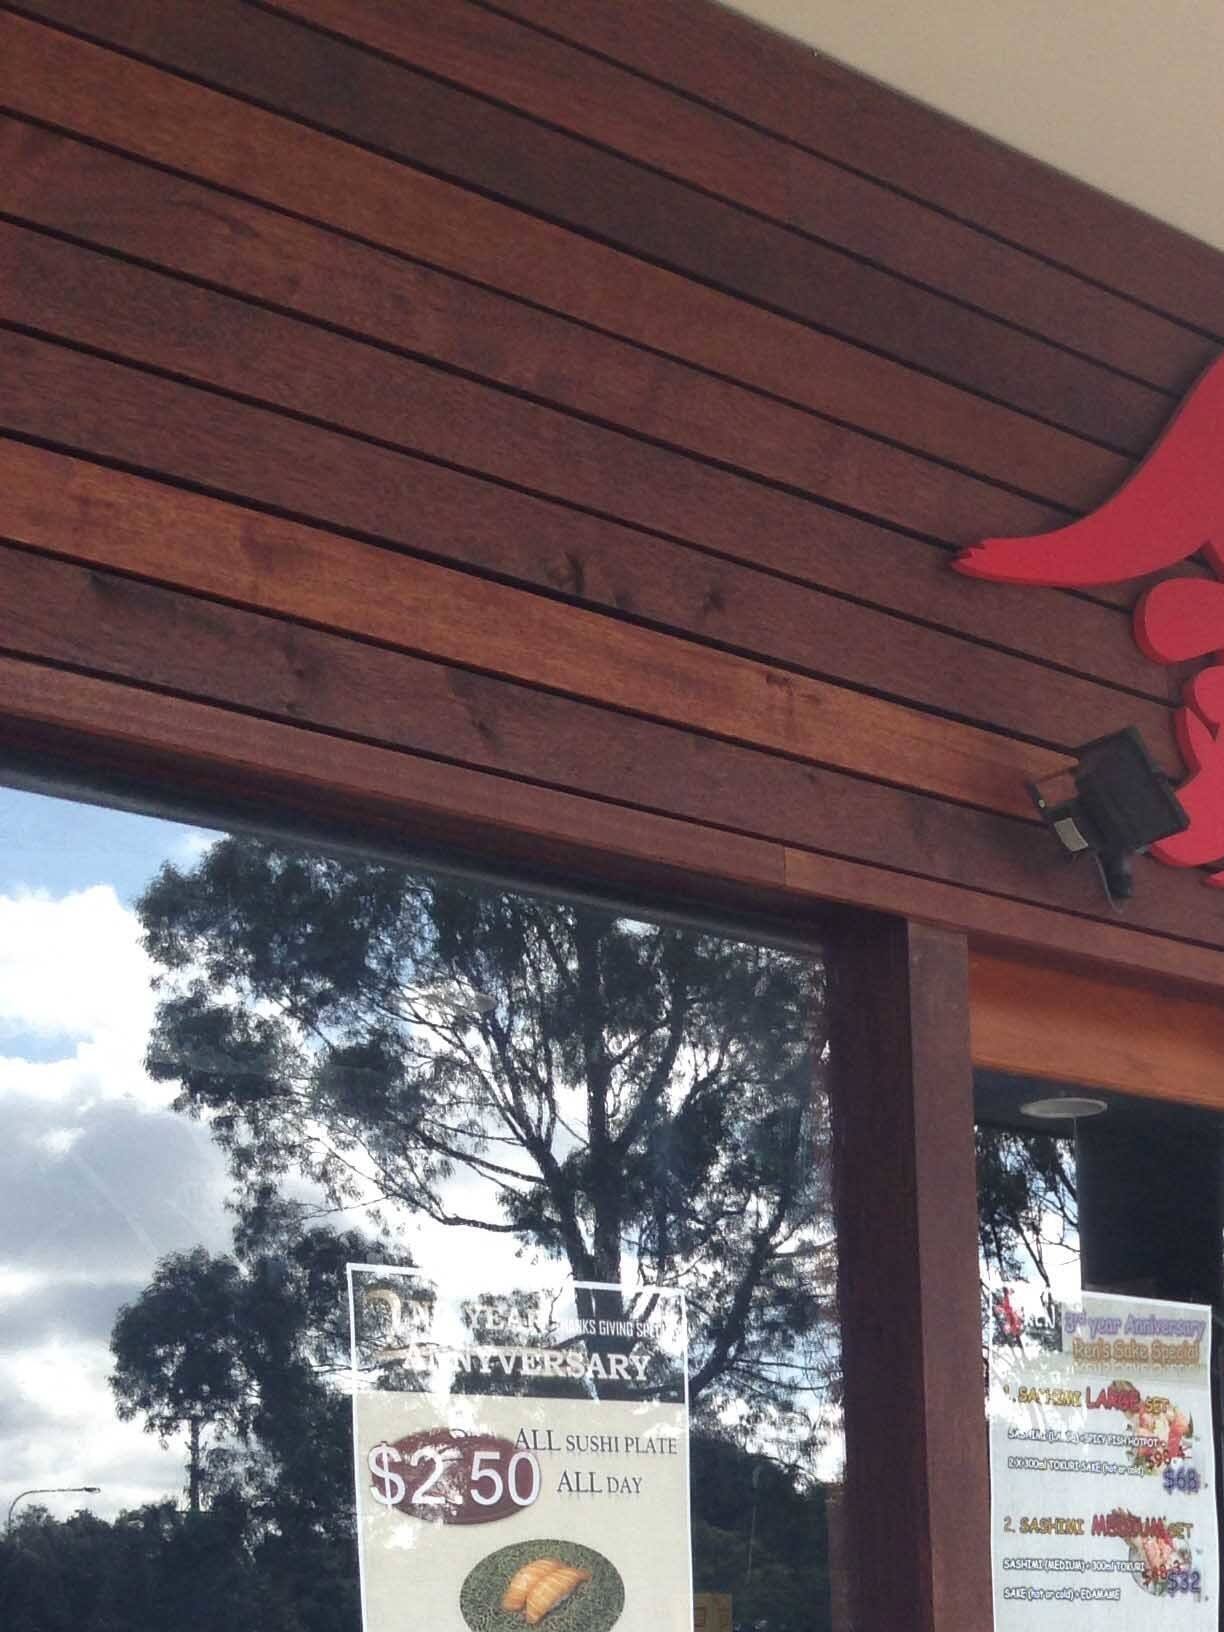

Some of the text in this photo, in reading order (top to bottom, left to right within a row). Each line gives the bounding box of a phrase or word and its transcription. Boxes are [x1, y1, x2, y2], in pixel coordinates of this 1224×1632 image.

[599, 1319, 633, 1337] GIVING
[1124, 1313, 1207, 1338] Anniversary
[1113, 1340, 1149, 1362] Sake
[1151, 1340, 1201, 1364] Special
[1145, 1397, 1170, 1414] SET
[515, 1428, 678, 1455] ALL SUSHI PLATE
[368, 1441, 541, 1511] $2.50
[557, 1469, 643, 1495] ALL DAY
[1003, 1516, 1016, 1534] 2.
[1019, 1516, 1085, 1537] SASHIMI
[1167, 1521, 1194, 1539] SET
[1003, 1558, 1044, 1571] SASHIMI
[1003, 1587, 1027, 1600] SAKE
[1080, 1588, 1121, 1601] EDAMAME
